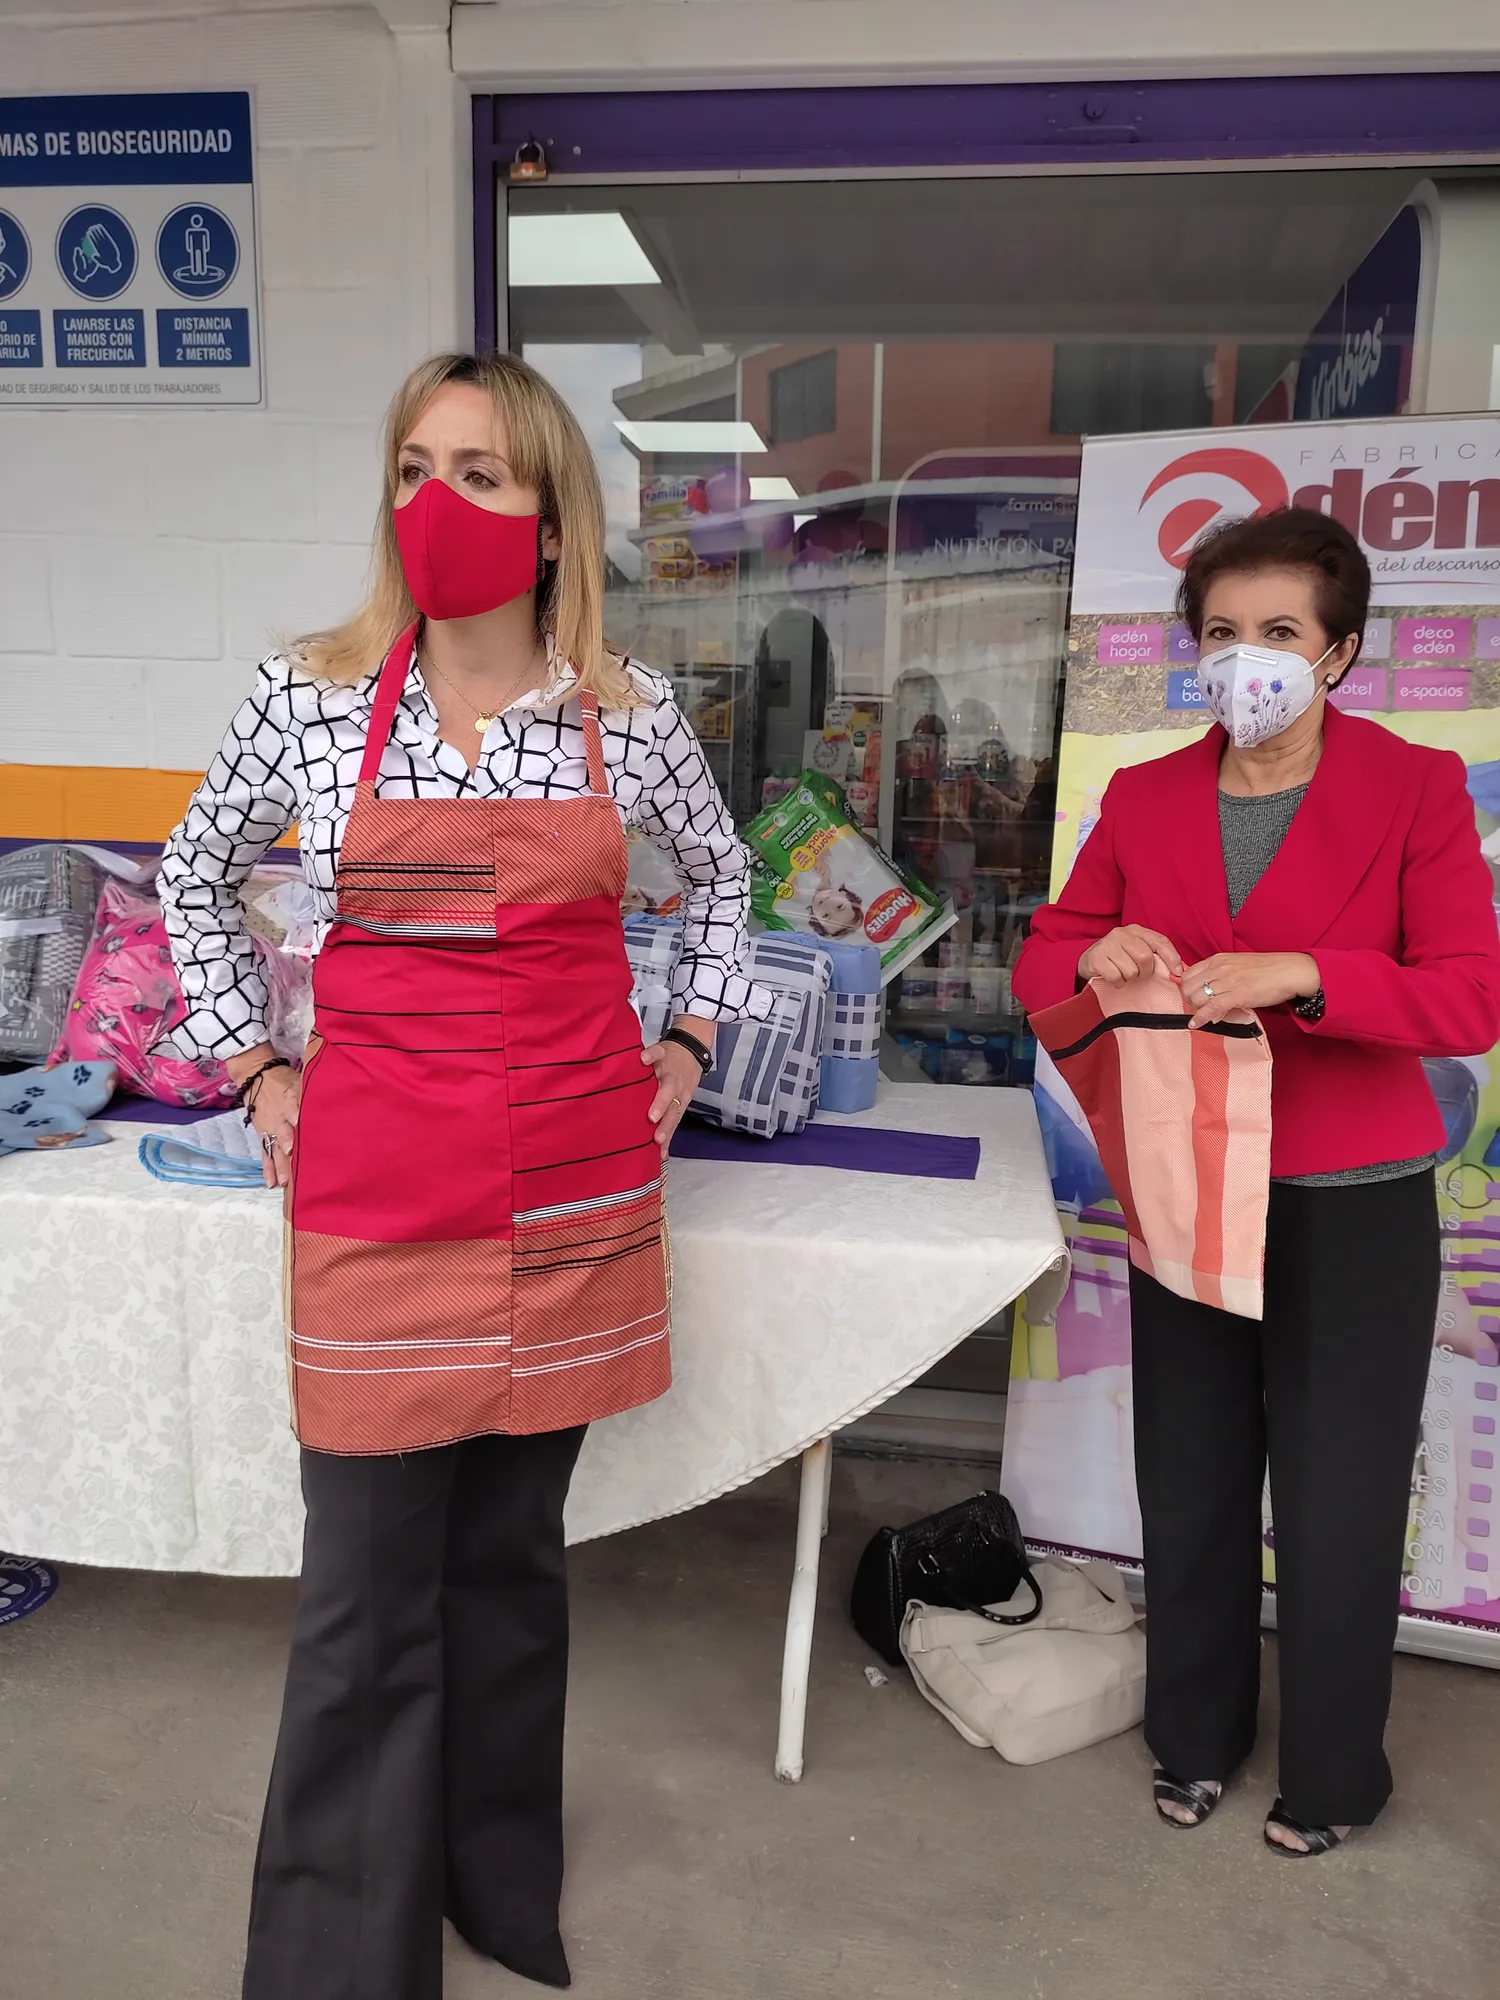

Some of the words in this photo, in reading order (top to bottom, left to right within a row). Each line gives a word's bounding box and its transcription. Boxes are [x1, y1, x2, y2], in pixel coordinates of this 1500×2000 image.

[44, 132, 71, 156] DE
[77, 129, 232, 155] BIOSEGURIDAD
[63, 318, 111, 331] LAVARSE
[113, 318, 135, 331] LAS
[174, 317, 232, 331] DISTANCIA
[23, 333, 37, 345] DE
[67, 333, 107, 346] MANOS
[109, 333, 133, 346] CON
[182, 330, 226, 345] MÍNIMA
[67, 348, 135, 361] FRECUENCIA
[176, 347, 184, 361] 2
[185, 347, 233, 361] METROS
[15, 383, 26, 394] DE
[29, 383, 79, 394] SEGURIDAD
[80, 383, 87, 394] Y
[88, 383, 118, 394] SALUD
[120, 383, 132, 394] DE
[134, 383, 152, 394] LOS
[154, 383, 222, 394] TRABAJADORES
[933, 532, 1044, 554] NUTRICIÓN
[1376, 557, 1410, 573] del
[1110, 630, 1148, 644] edén
[1414, 625, 1455, 640] deco
[1109, 644, 1152, 660] hogar
[1412, 640, 1456, 655] edén
[1400, 684, 1464, 700] e-spacios
[805, 829, 826, 851] Pack
[812, 826, 837, 856] Ahorra
[768, 874, 782, 888] 100
[866, 891, 914, 935] HUGGIES
